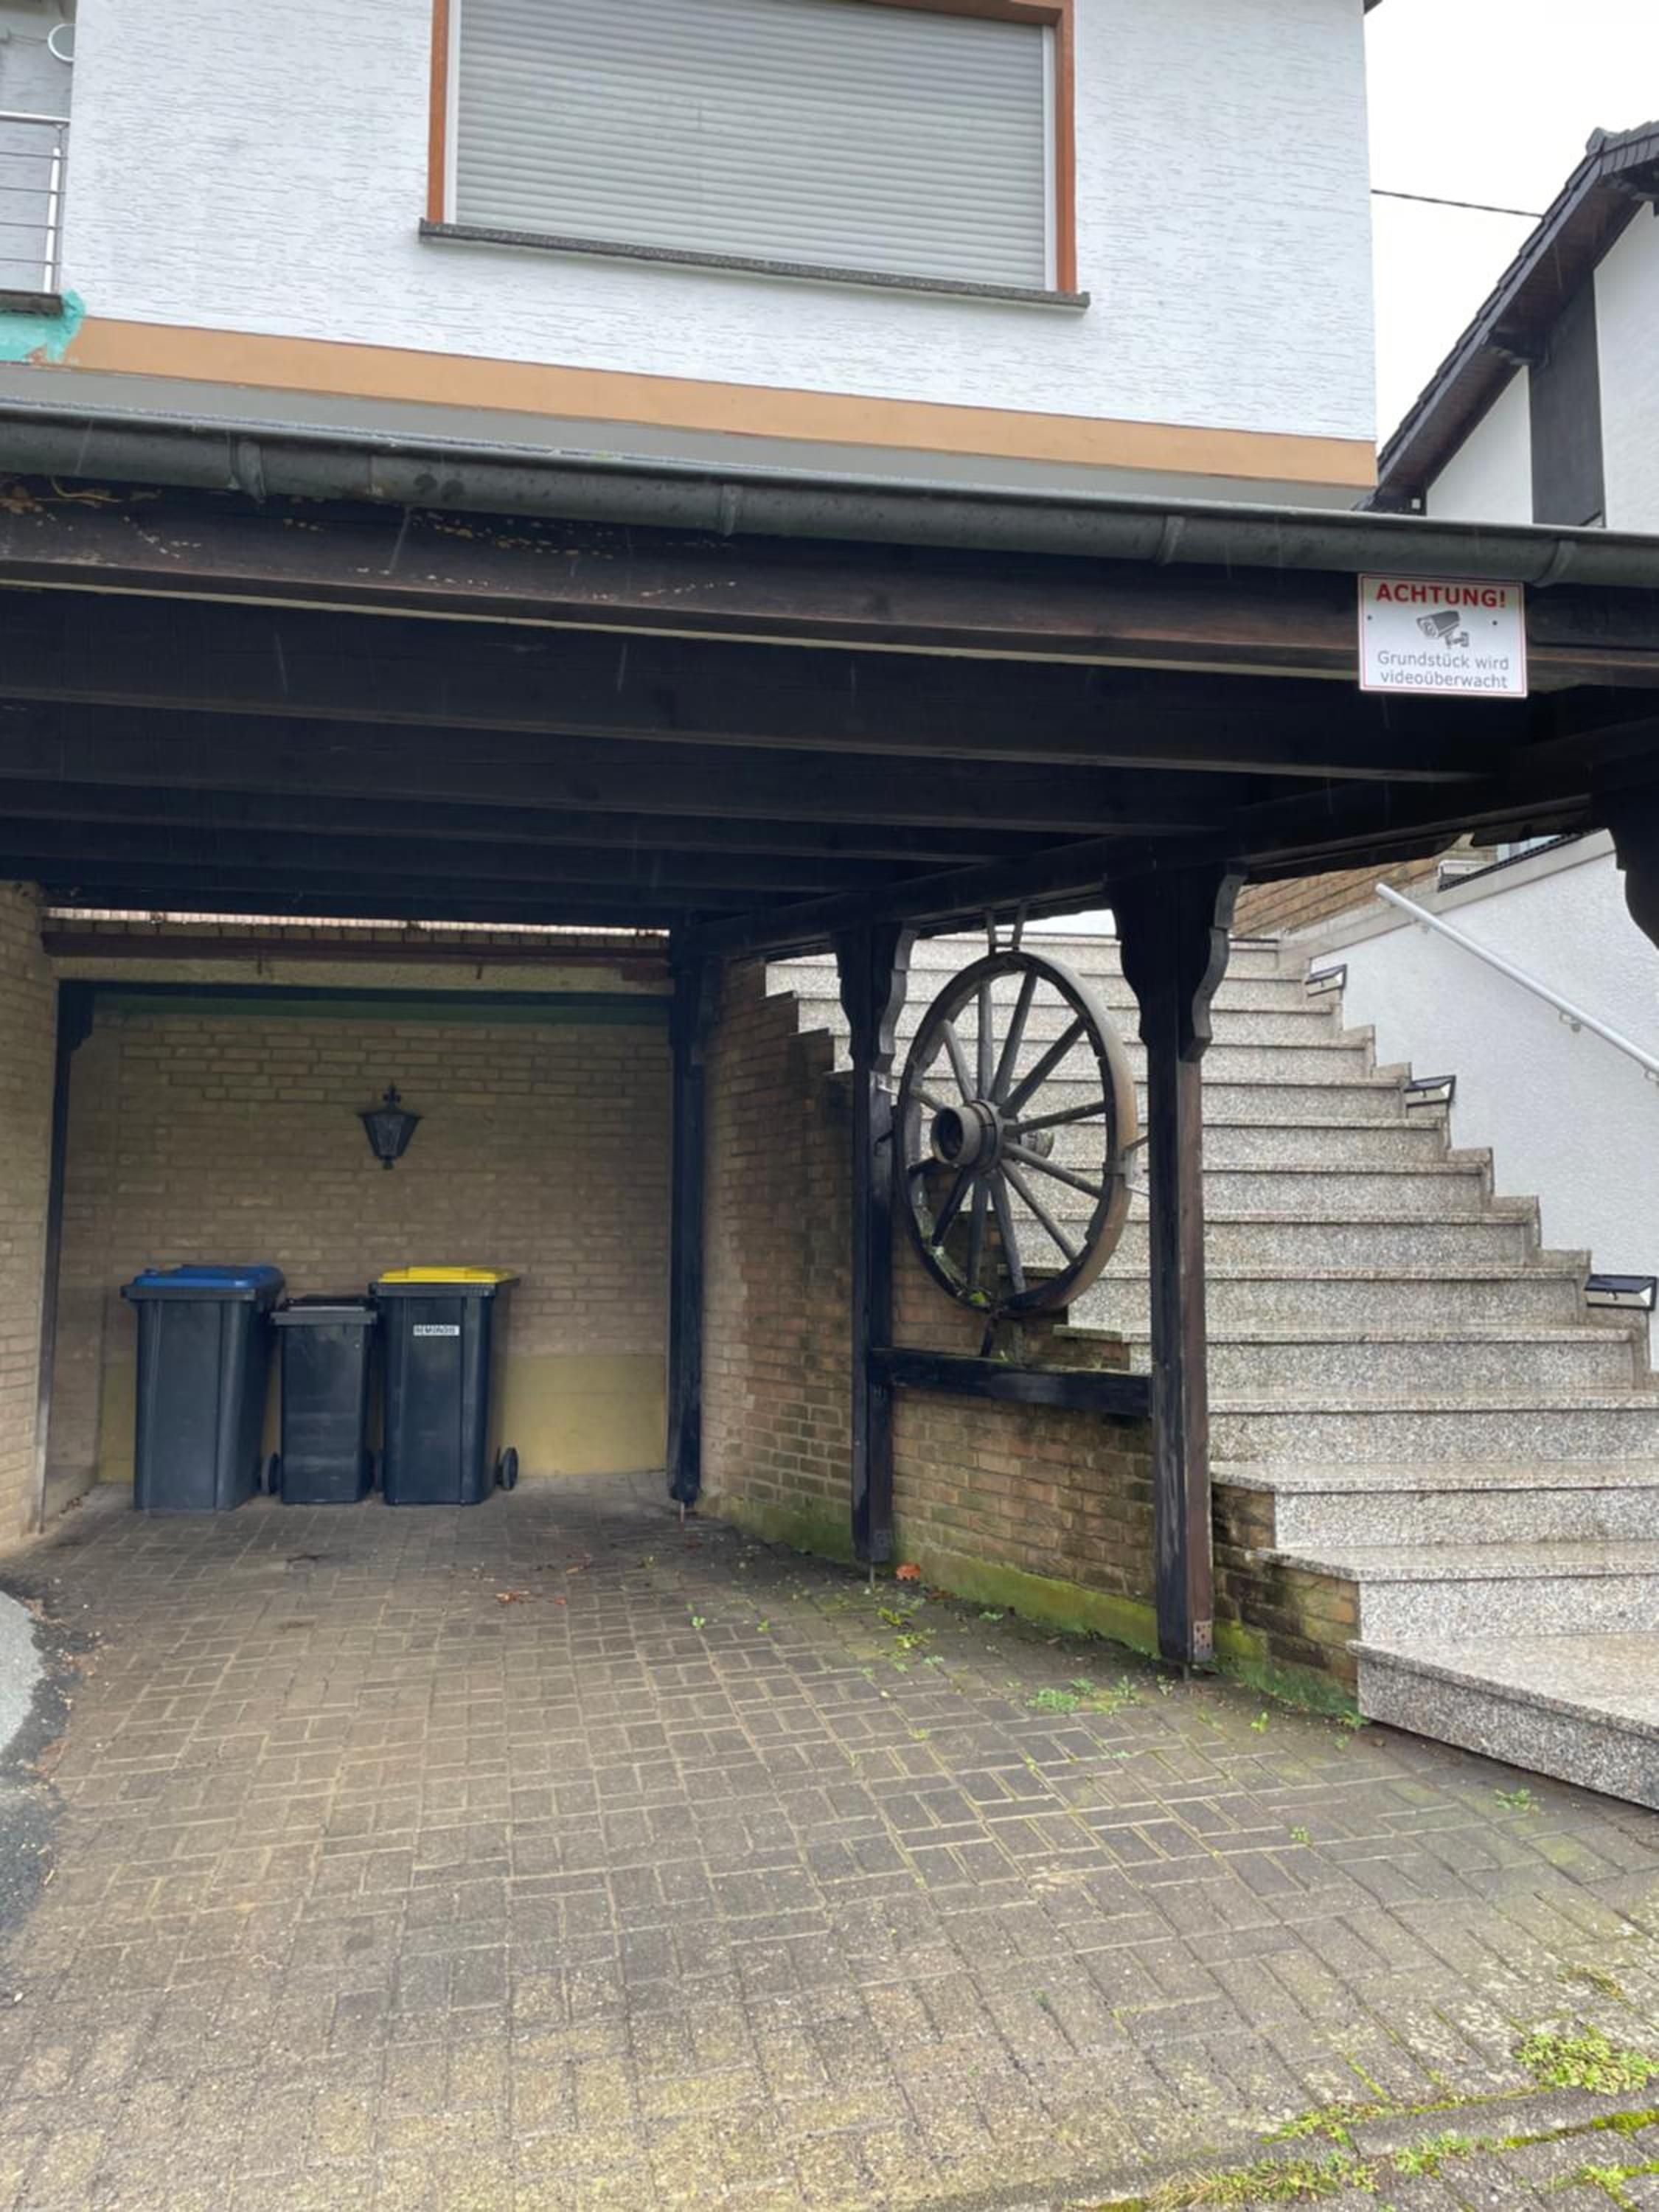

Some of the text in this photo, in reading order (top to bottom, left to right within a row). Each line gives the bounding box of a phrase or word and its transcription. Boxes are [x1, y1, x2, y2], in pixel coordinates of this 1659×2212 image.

[1376, 582, 1506, 608] ACHTUNG!
[1377, 650, 1509, 670] Grundstück wird
[1380, 670, 1509, 689] videoüberwacht
